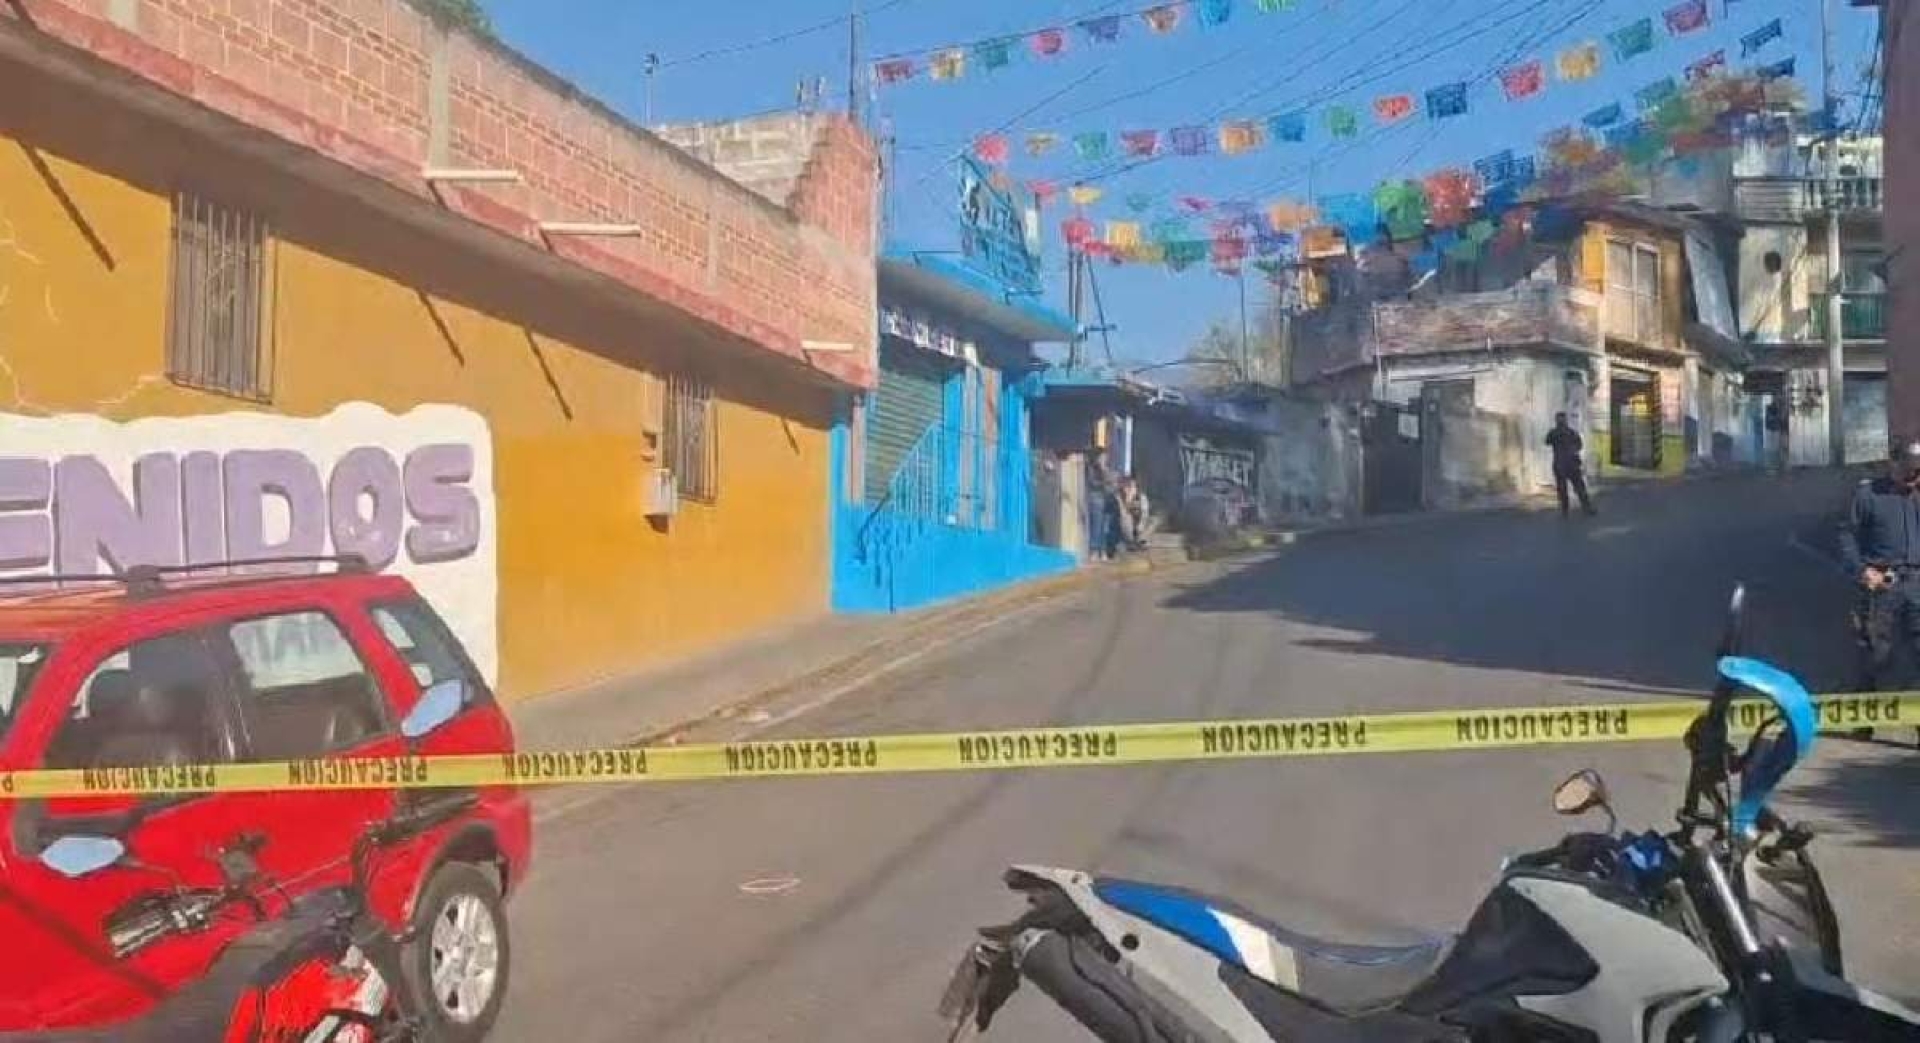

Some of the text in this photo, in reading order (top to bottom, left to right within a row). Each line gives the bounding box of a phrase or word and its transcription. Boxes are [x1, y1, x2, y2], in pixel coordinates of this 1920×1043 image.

[1202, 721, 1366, 753] PRECAUCION
[1457, 709, 1629, 741] PRECAUCION
[504, 749, 649, 777] PRECAUCION
[725, 740, 878, 772] PRECAUCION
[957, 732, 1118, 763] PRECAUCION
[82, 767, 215, 790] PRECAUCION
[288, 757, 428, 784] PRECAUCION
